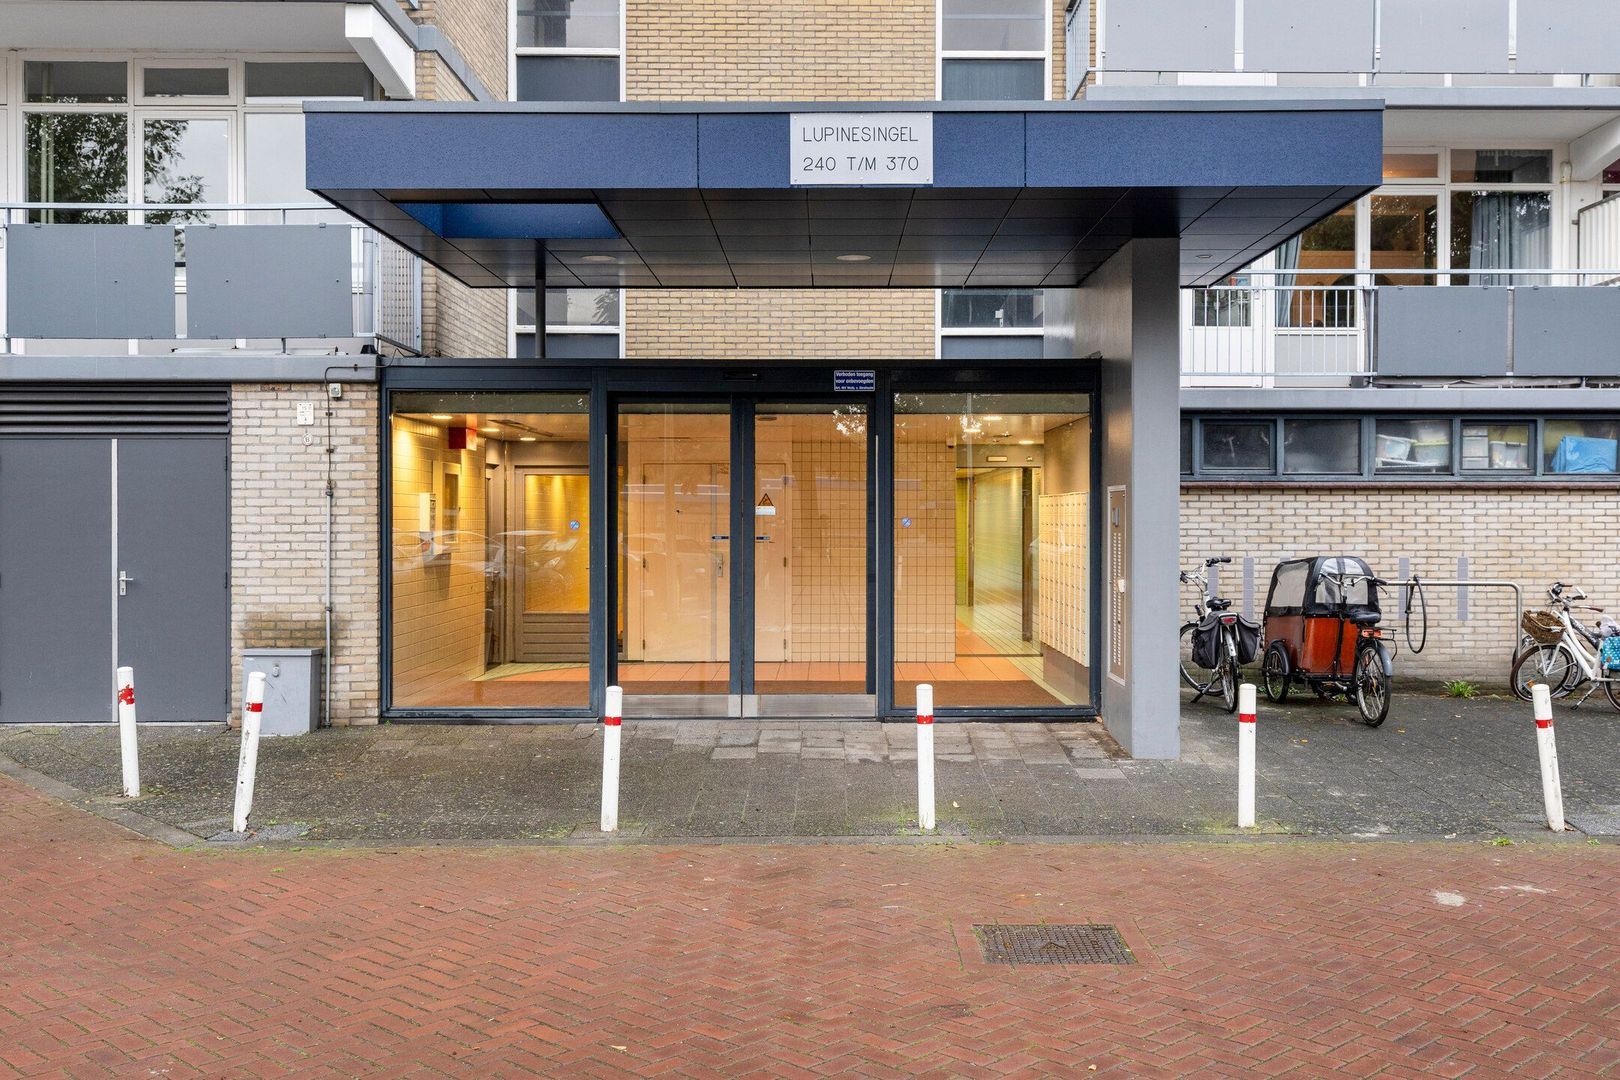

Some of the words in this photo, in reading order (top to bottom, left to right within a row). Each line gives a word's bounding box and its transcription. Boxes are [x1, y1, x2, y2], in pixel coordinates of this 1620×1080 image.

[802, 126, 919, 142] LUPINESINGEL
[803, 156, 837, 171] 240
[846, 156, 877, 171] T/M
[886, 156, 919, 171] 370
